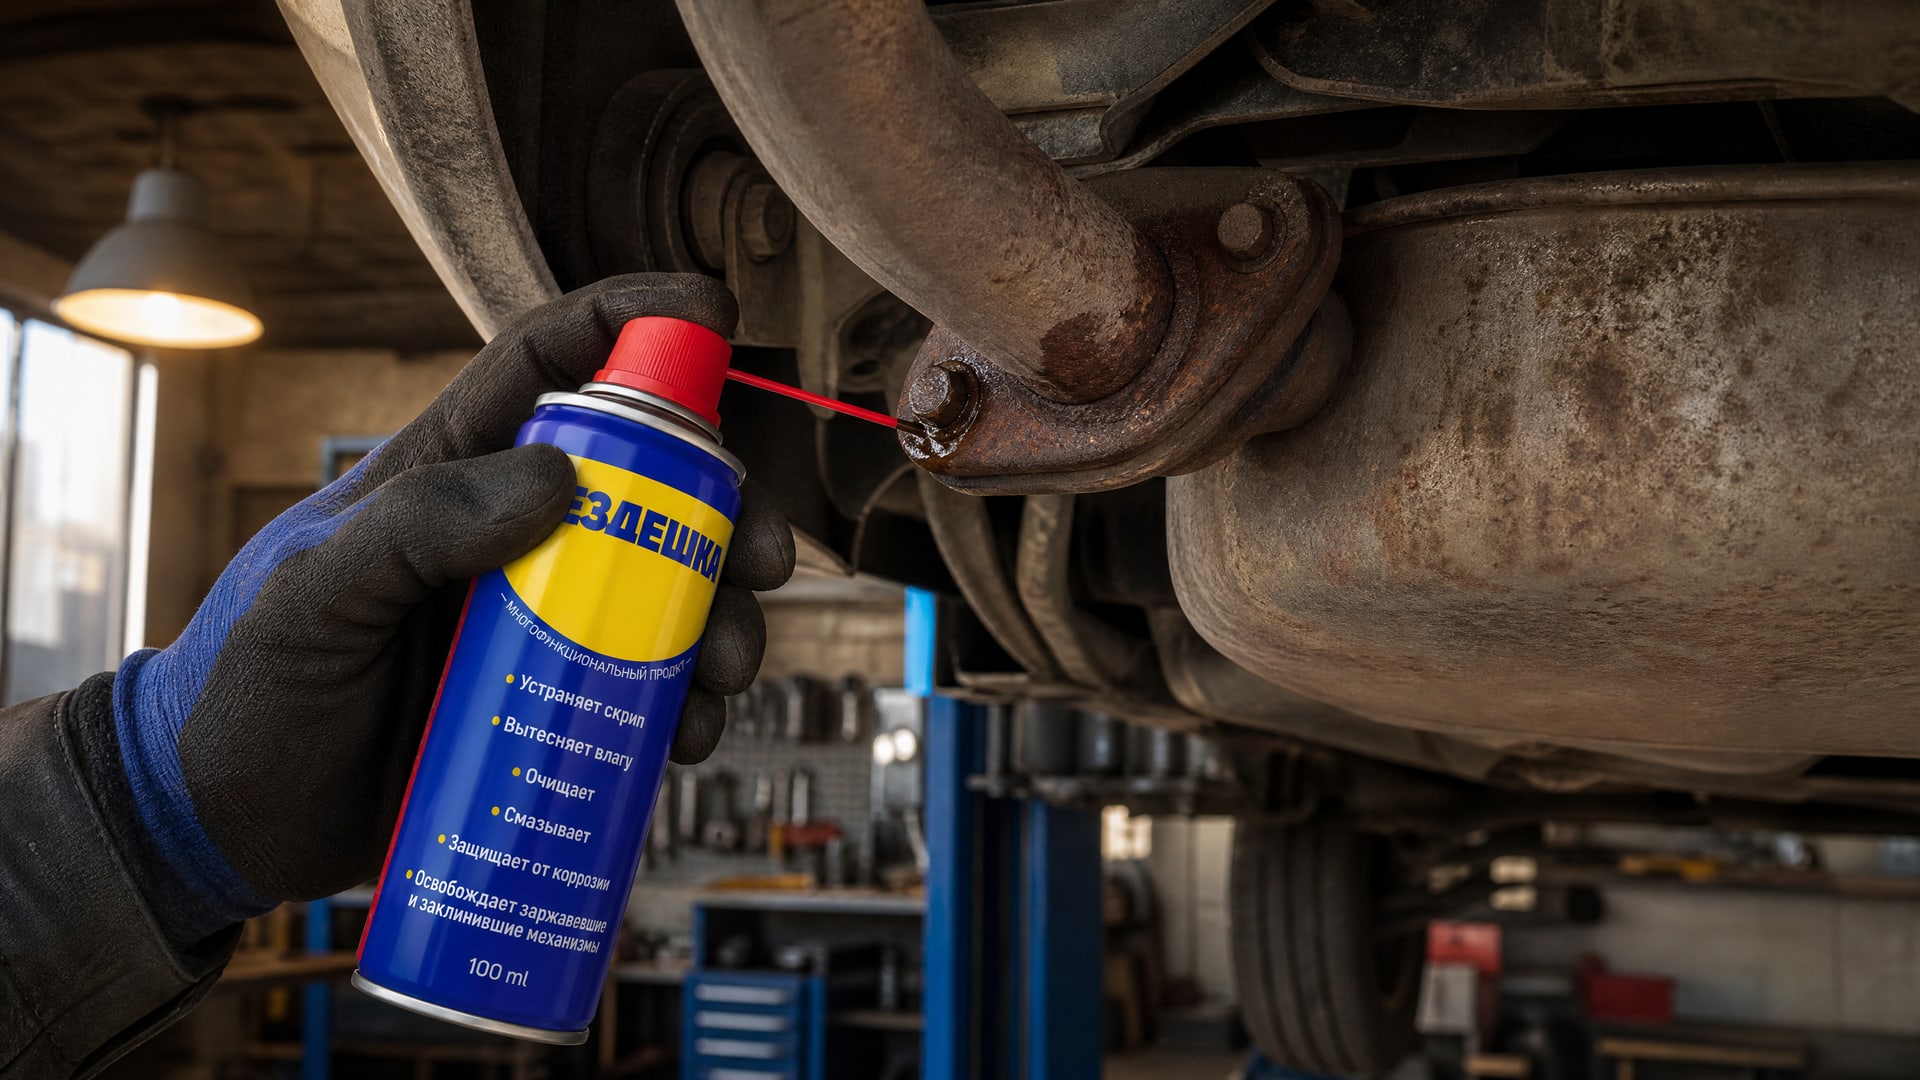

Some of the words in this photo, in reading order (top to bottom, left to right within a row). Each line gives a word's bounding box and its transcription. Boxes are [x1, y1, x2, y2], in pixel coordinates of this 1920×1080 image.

[563, 485, 722, 584] ЕЗДЕШКА
[505, 600, 647, 681] МНОГОФУНКЦИОНАЛЬНЫЙ
[519, 674, 602, 714] Устраняет
[604, 705, 645, 729] скрип
[503, 715, 593, 757] Вытесняет
[594, 747, 633, 772] влагу
[525, 767, 595, 802] Очищает
[504, 806, 591, 843] Смазывает
[448, 834, 530, 871] Защищает
[531, 862, 550, 877] от
[552, 867, 611, 891] коррозии
[407, 894, 416, 908] и
[419, 898, 524, 938] заклинившие
[526, 928, 600, 954] механизмы
[414, 869, 517, 914] Освобождает
[519, 903, 607, 934] заржавевшие
[469, 957, 502, 981] 100
[505, 970, 529, 988] ml
